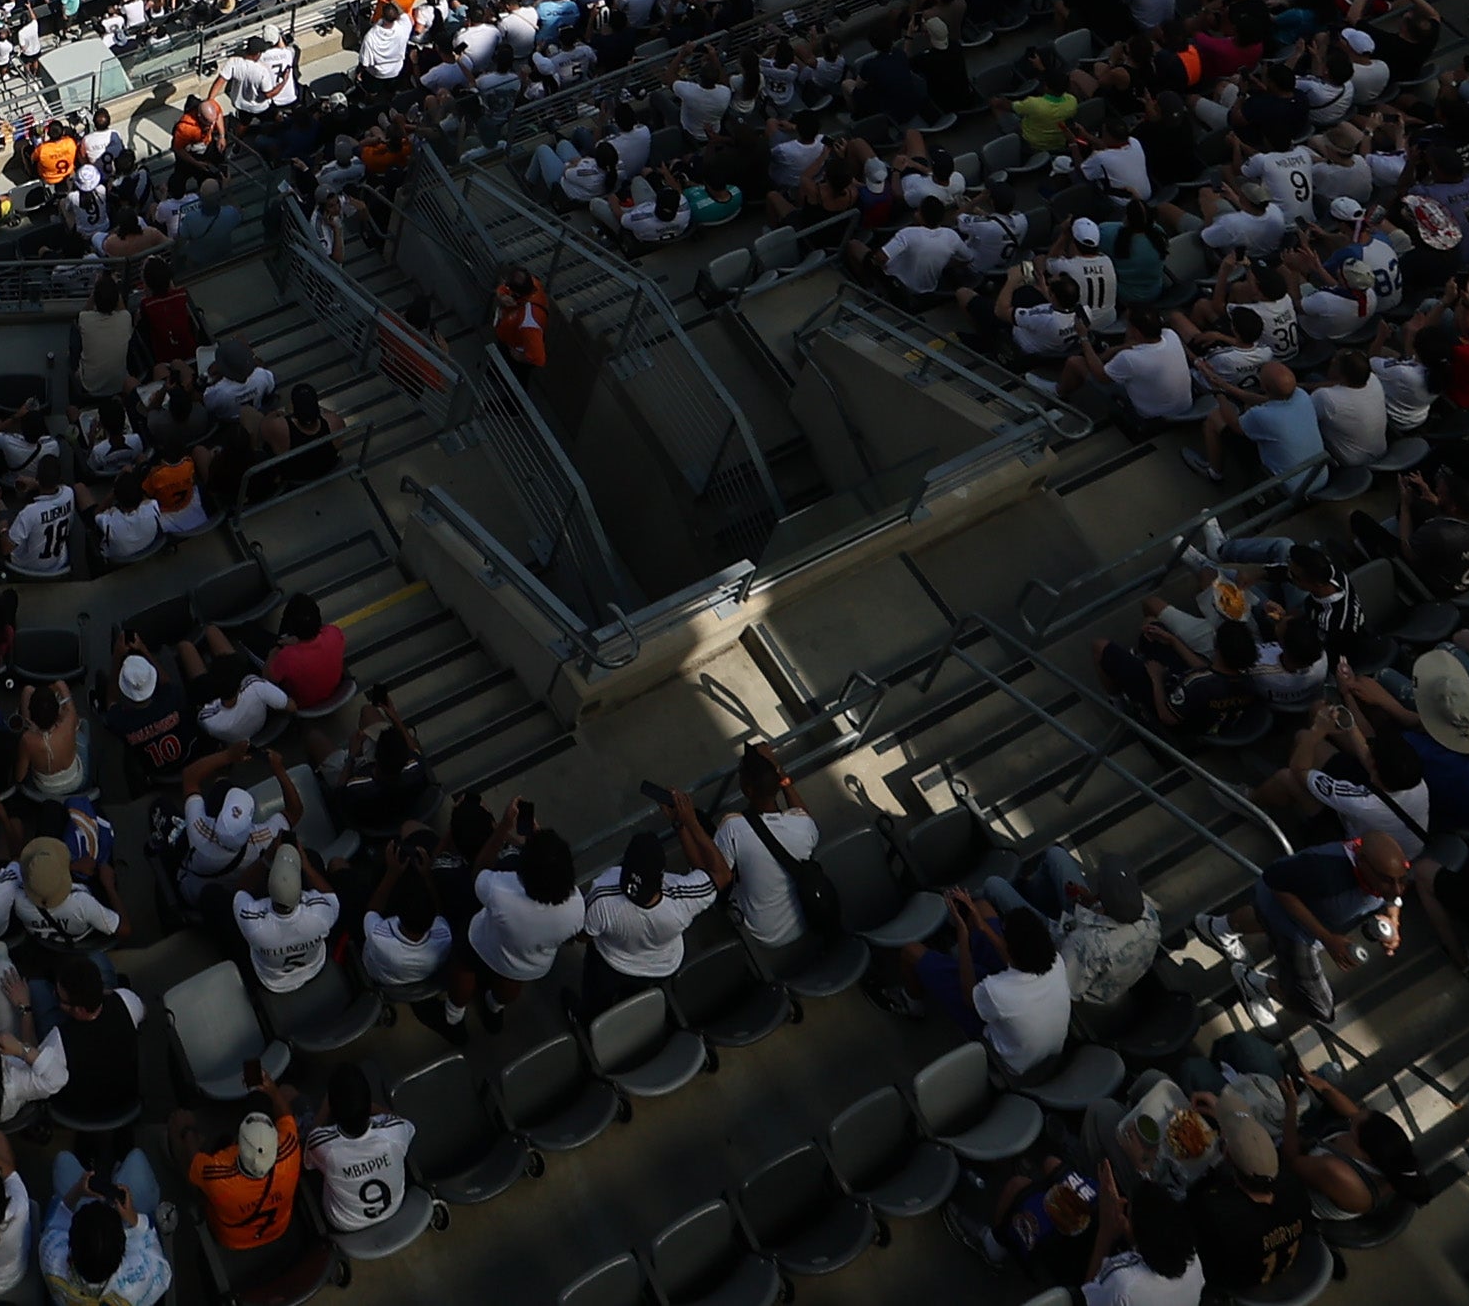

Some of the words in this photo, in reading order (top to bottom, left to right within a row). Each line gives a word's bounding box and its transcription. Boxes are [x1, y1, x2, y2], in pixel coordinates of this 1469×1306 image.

[572, 64, 583, 83] 5
[102, 152, 114, 174] 8
[1290, 172, 1310, 203] 9
[87, 200, 100, 226] 9
[1084, 265, 1105, 277] BALE
[1087, 278, 1105, 308] 11
[1273, 324, 1298, 352] 30
[141, 733, 182, 769] 10
[283, 955, 307, 974] 5
[359, 1179, 392, 1218] 9
